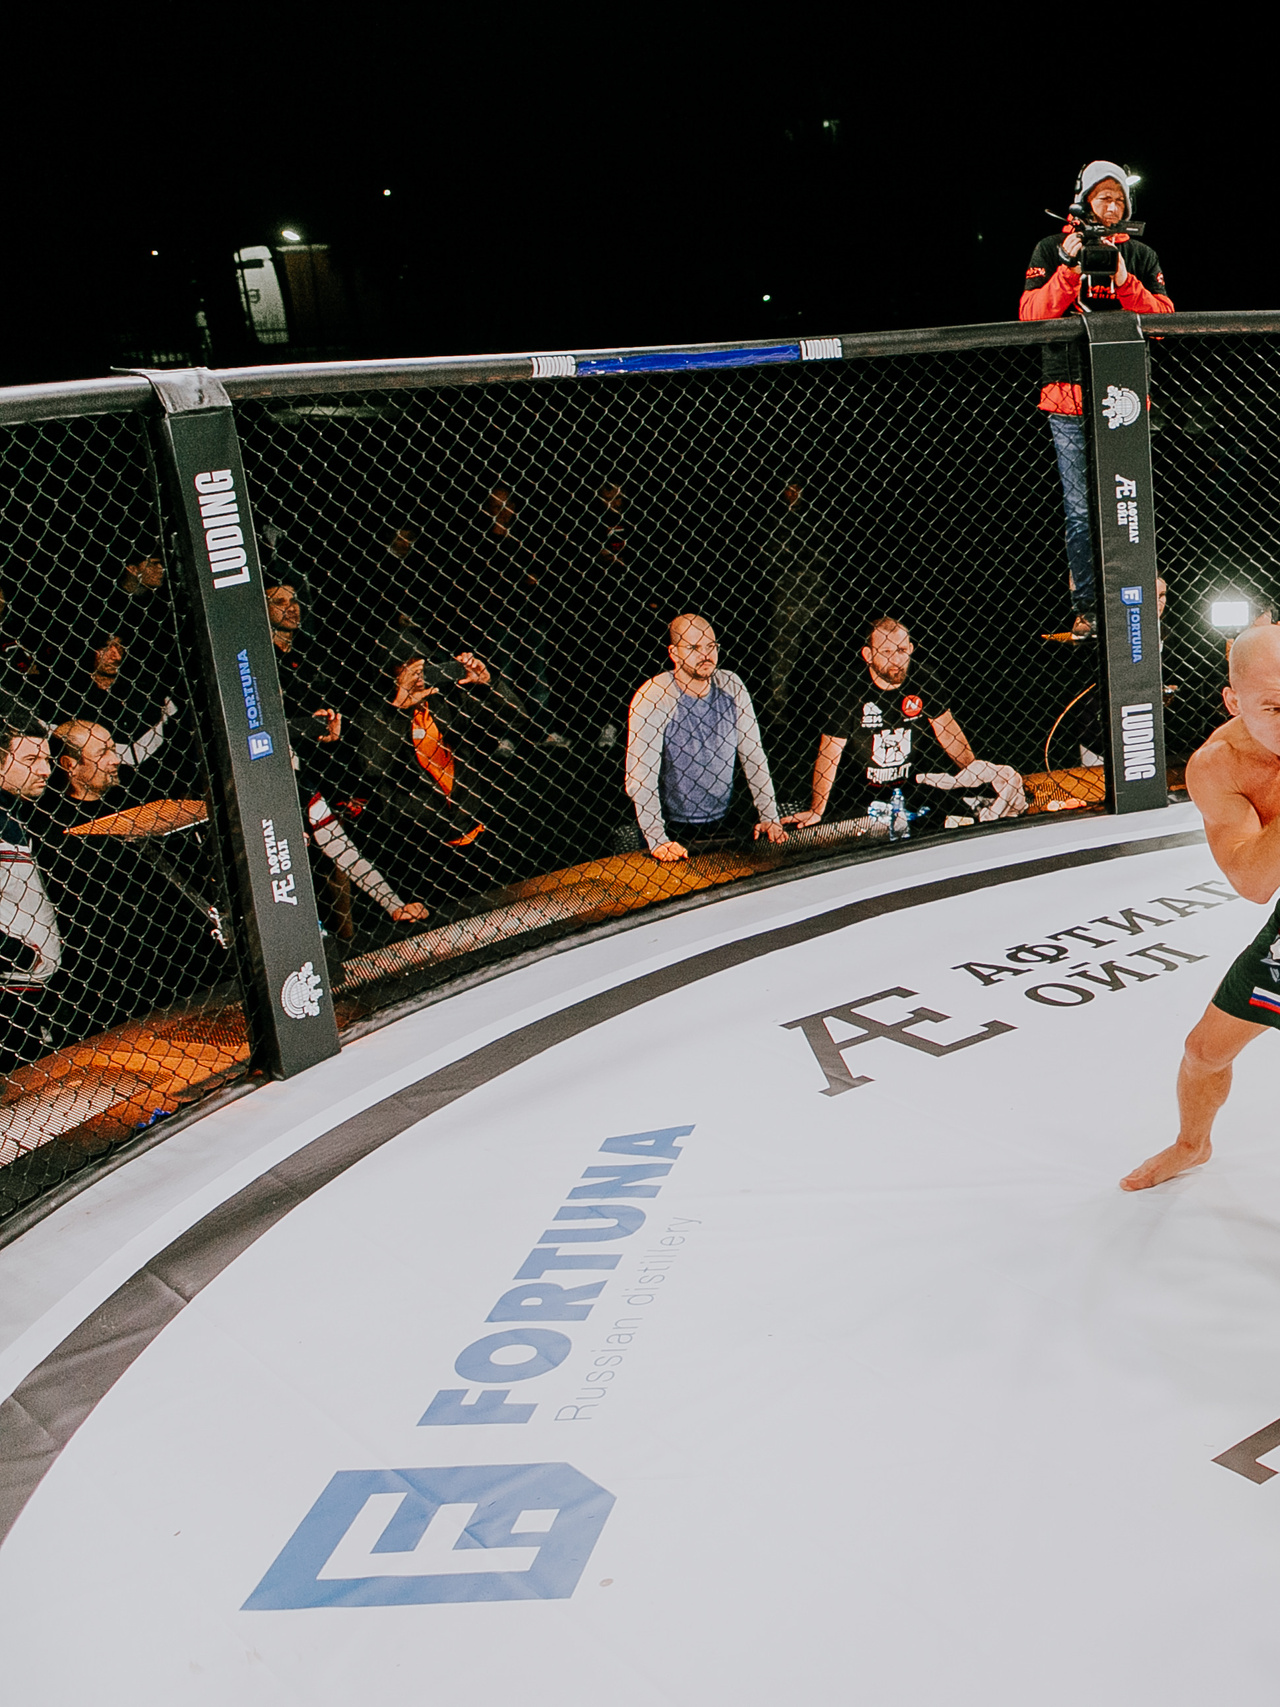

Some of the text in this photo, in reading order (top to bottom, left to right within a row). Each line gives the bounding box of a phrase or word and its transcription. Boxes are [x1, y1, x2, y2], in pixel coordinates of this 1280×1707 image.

[800, 338, 843, 361] LUDING
[194, 468, 251, 589] LUDING
[1130, 607, 1143, 664] FORTUNA
[236, 648, 260, 730] FORTUNA
[1121, 702, 1156, 782] LUDING
[951, 880, 1241, 987] АФТИАГ
[1024, 943, 1210, 1007] ОЙЛ
[416, 1124, 696, 1426] FORTUNA
[554, 1216, 702, 1422] Russian distillery
